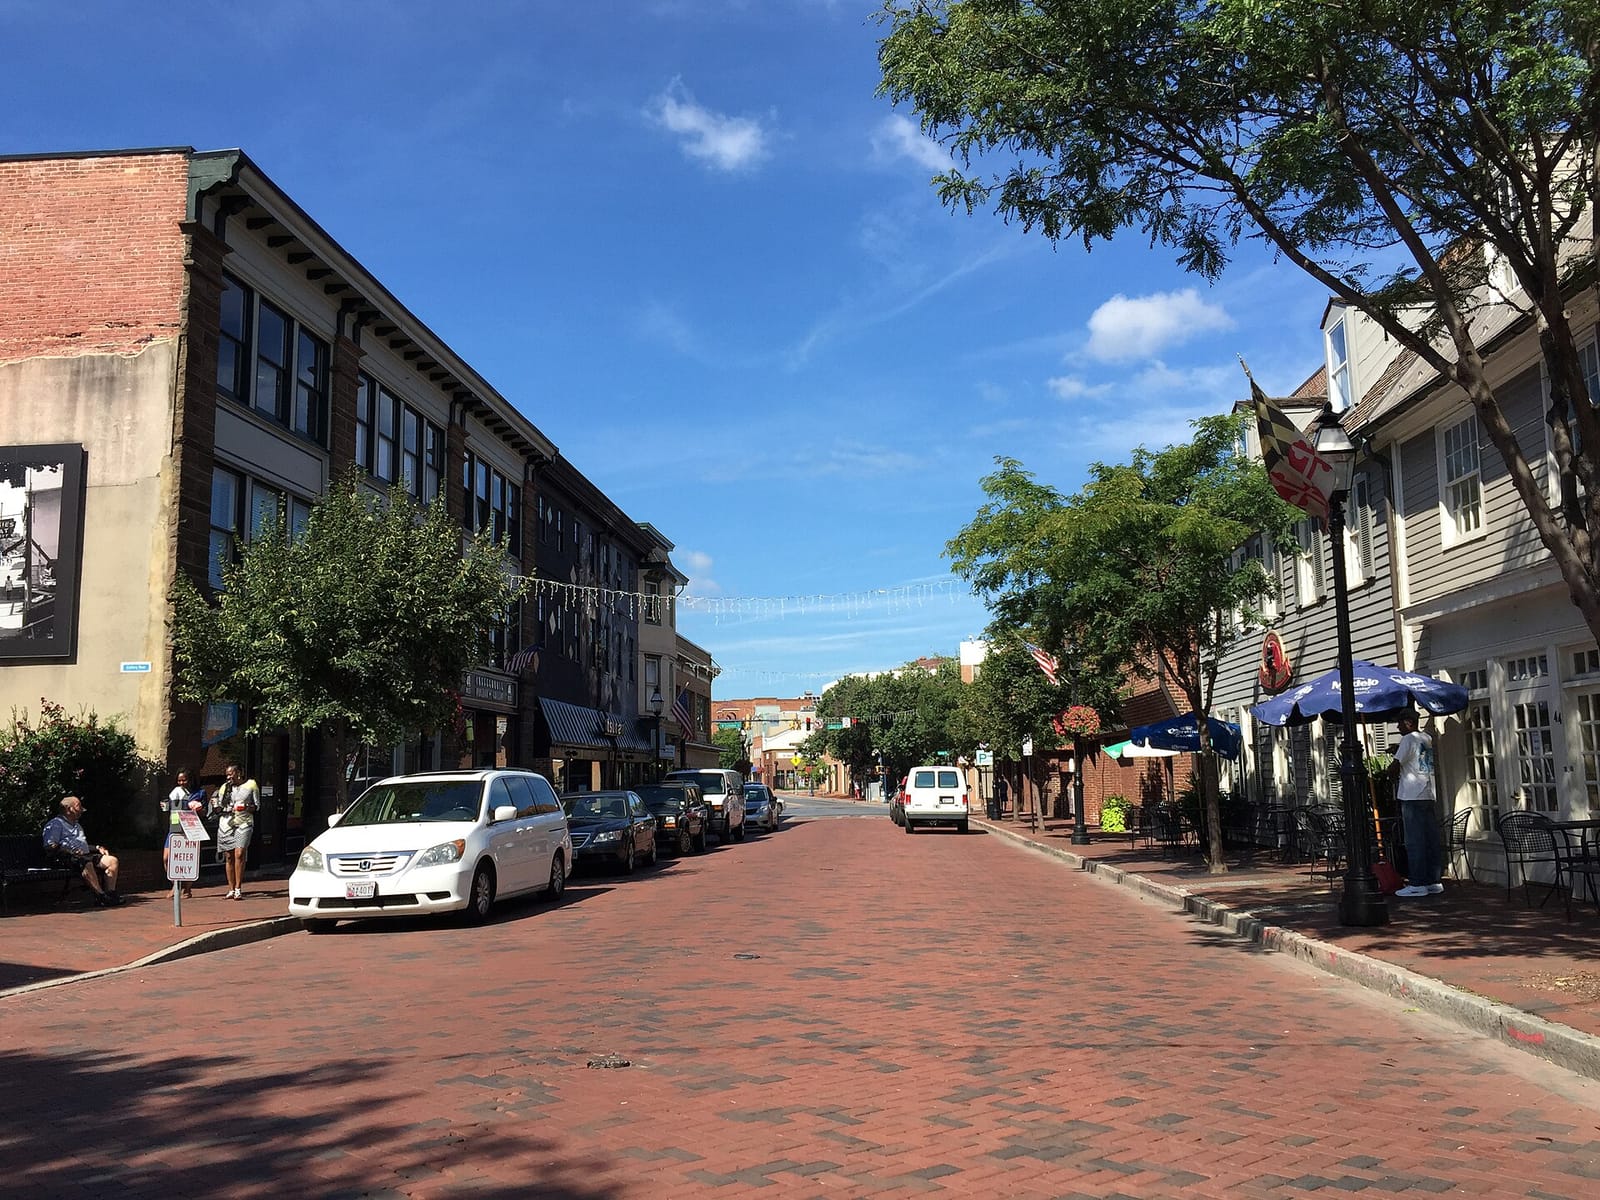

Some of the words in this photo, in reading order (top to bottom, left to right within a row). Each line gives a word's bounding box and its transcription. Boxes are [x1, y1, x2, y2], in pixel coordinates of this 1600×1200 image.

[1331, 679, 1379, 690] Mdelo
[979, 753, 987, 763] P
[172, 840, 182, 849] 30
[185, 839, 197, 848] MIN
[173, 853, 194, 861] METER
[174, 865, 192, 874] ONLY
